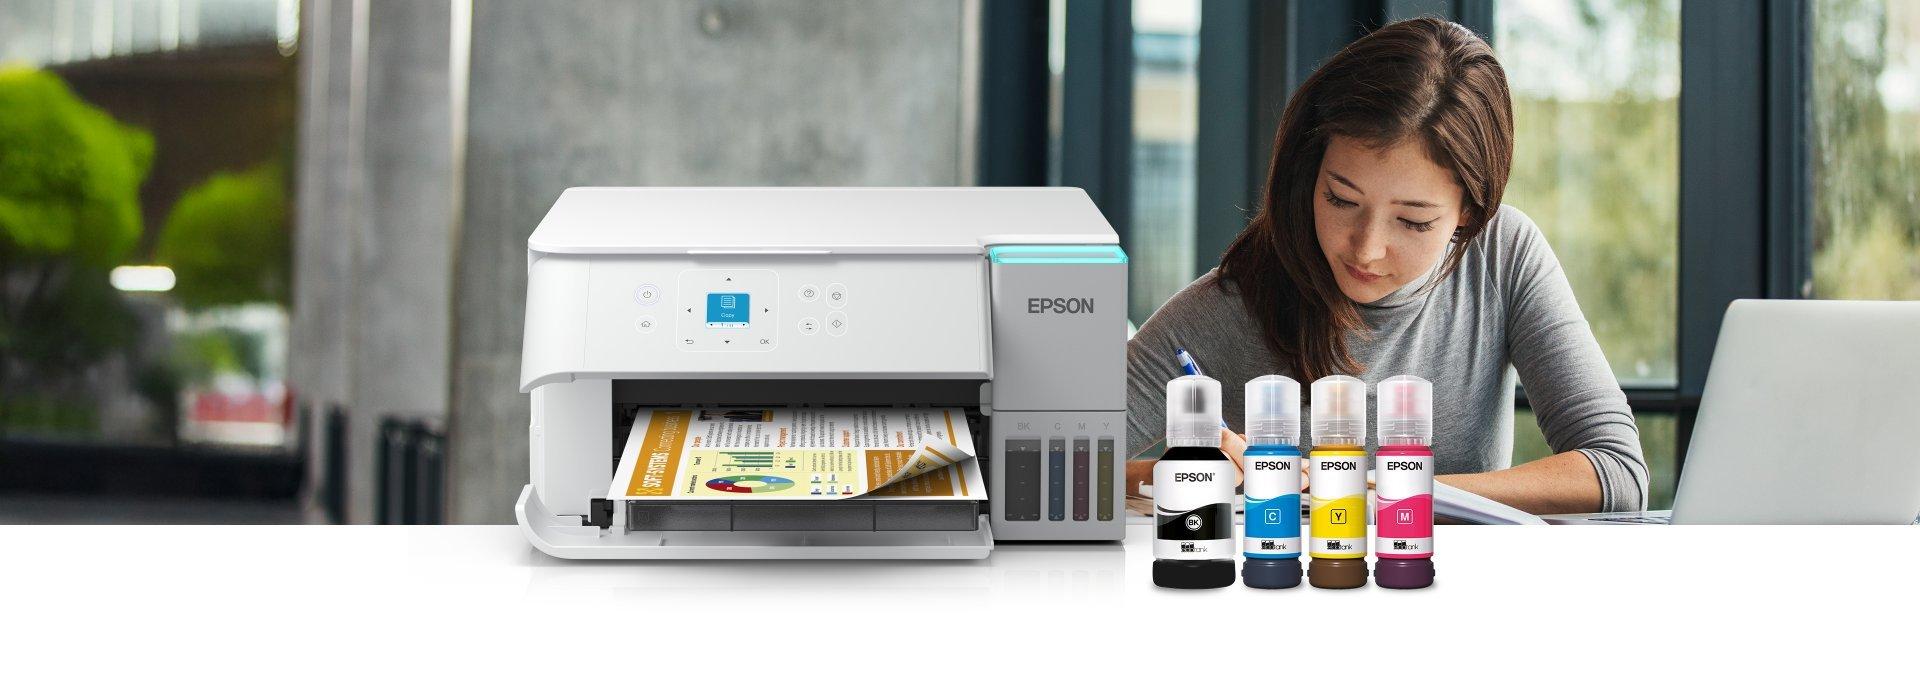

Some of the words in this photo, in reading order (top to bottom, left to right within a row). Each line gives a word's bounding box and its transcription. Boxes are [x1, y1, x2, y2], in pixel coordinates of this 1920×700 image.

[1027, 297, 1094, 314] EPSON
[1017, 422, 1031, 431] BK
[1054, 422, 1062, 431] C
[1078, 422, 1086, 431] M
[1103, 422, 1110, 431] Y
[1255, 461, 1291, 471] EPSON
[1321, 461, 1357, 471] EPSON
[1387, 461, 1423, 471] EPSON
[1268, 512, 1277, 521] C
[1335, 512, 1343, 521] Y
[1400, 512, 1410, 521] M
